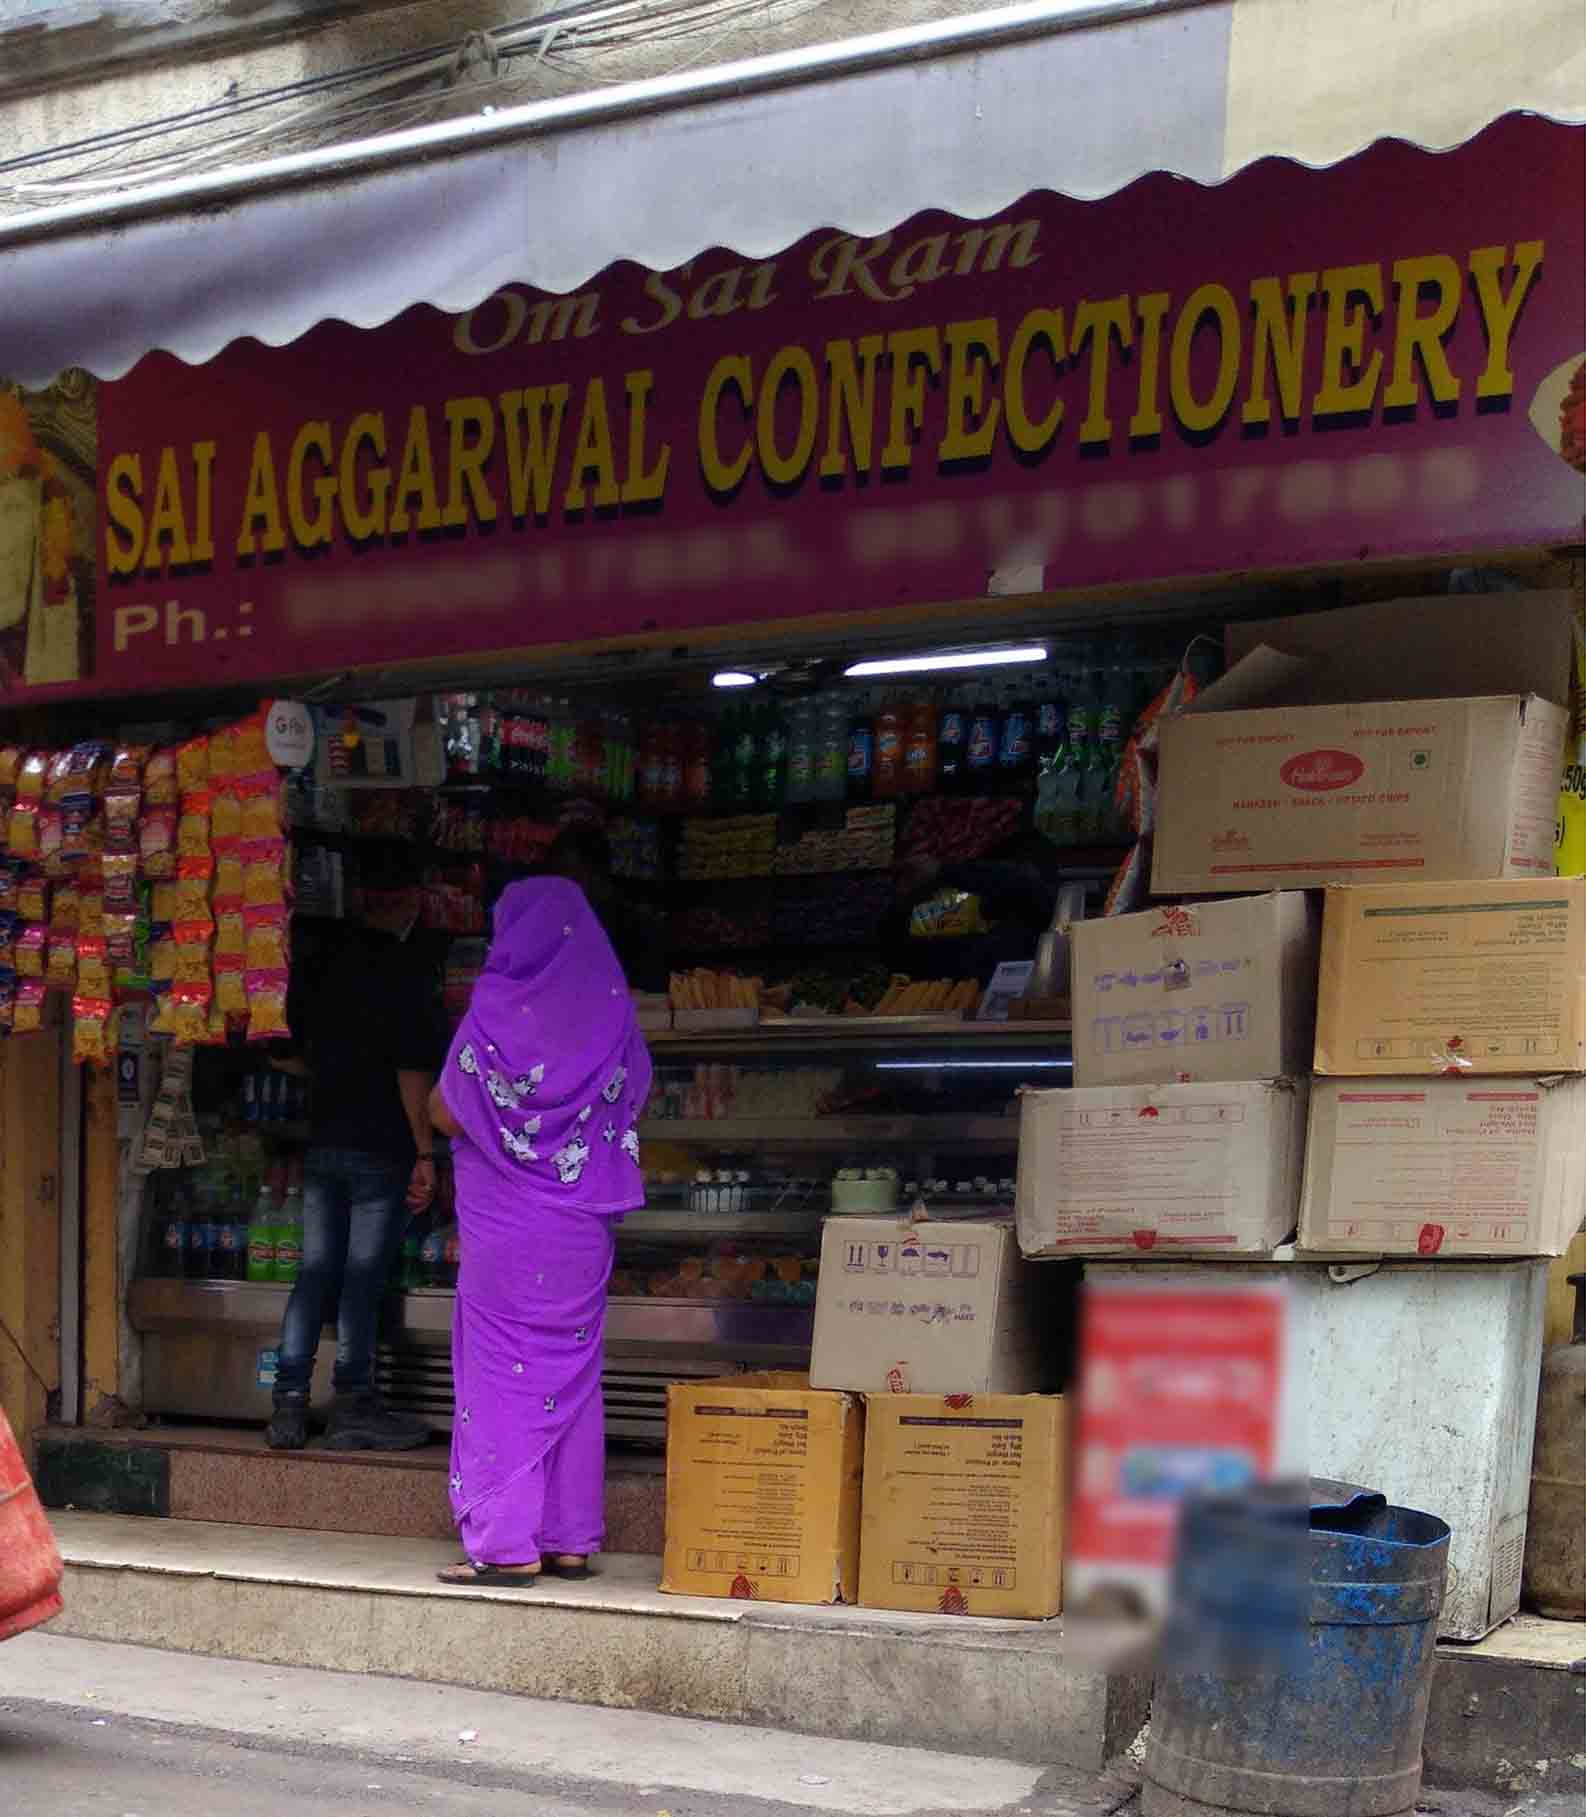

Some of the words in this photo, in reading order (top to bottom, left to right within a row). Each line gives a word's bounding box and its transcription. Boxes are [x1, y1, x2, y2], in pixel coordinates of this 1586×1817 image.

[453, 289, 602, 354] Om
[619, 262, 783, 334] Sai
[808, 219, 1046, 303] Ram
[106, 441, 216, 578] SAI
[237, 369, 673, 556] AGGARWAL
[702, 240, 1546, 488] CONFECTIONERY
